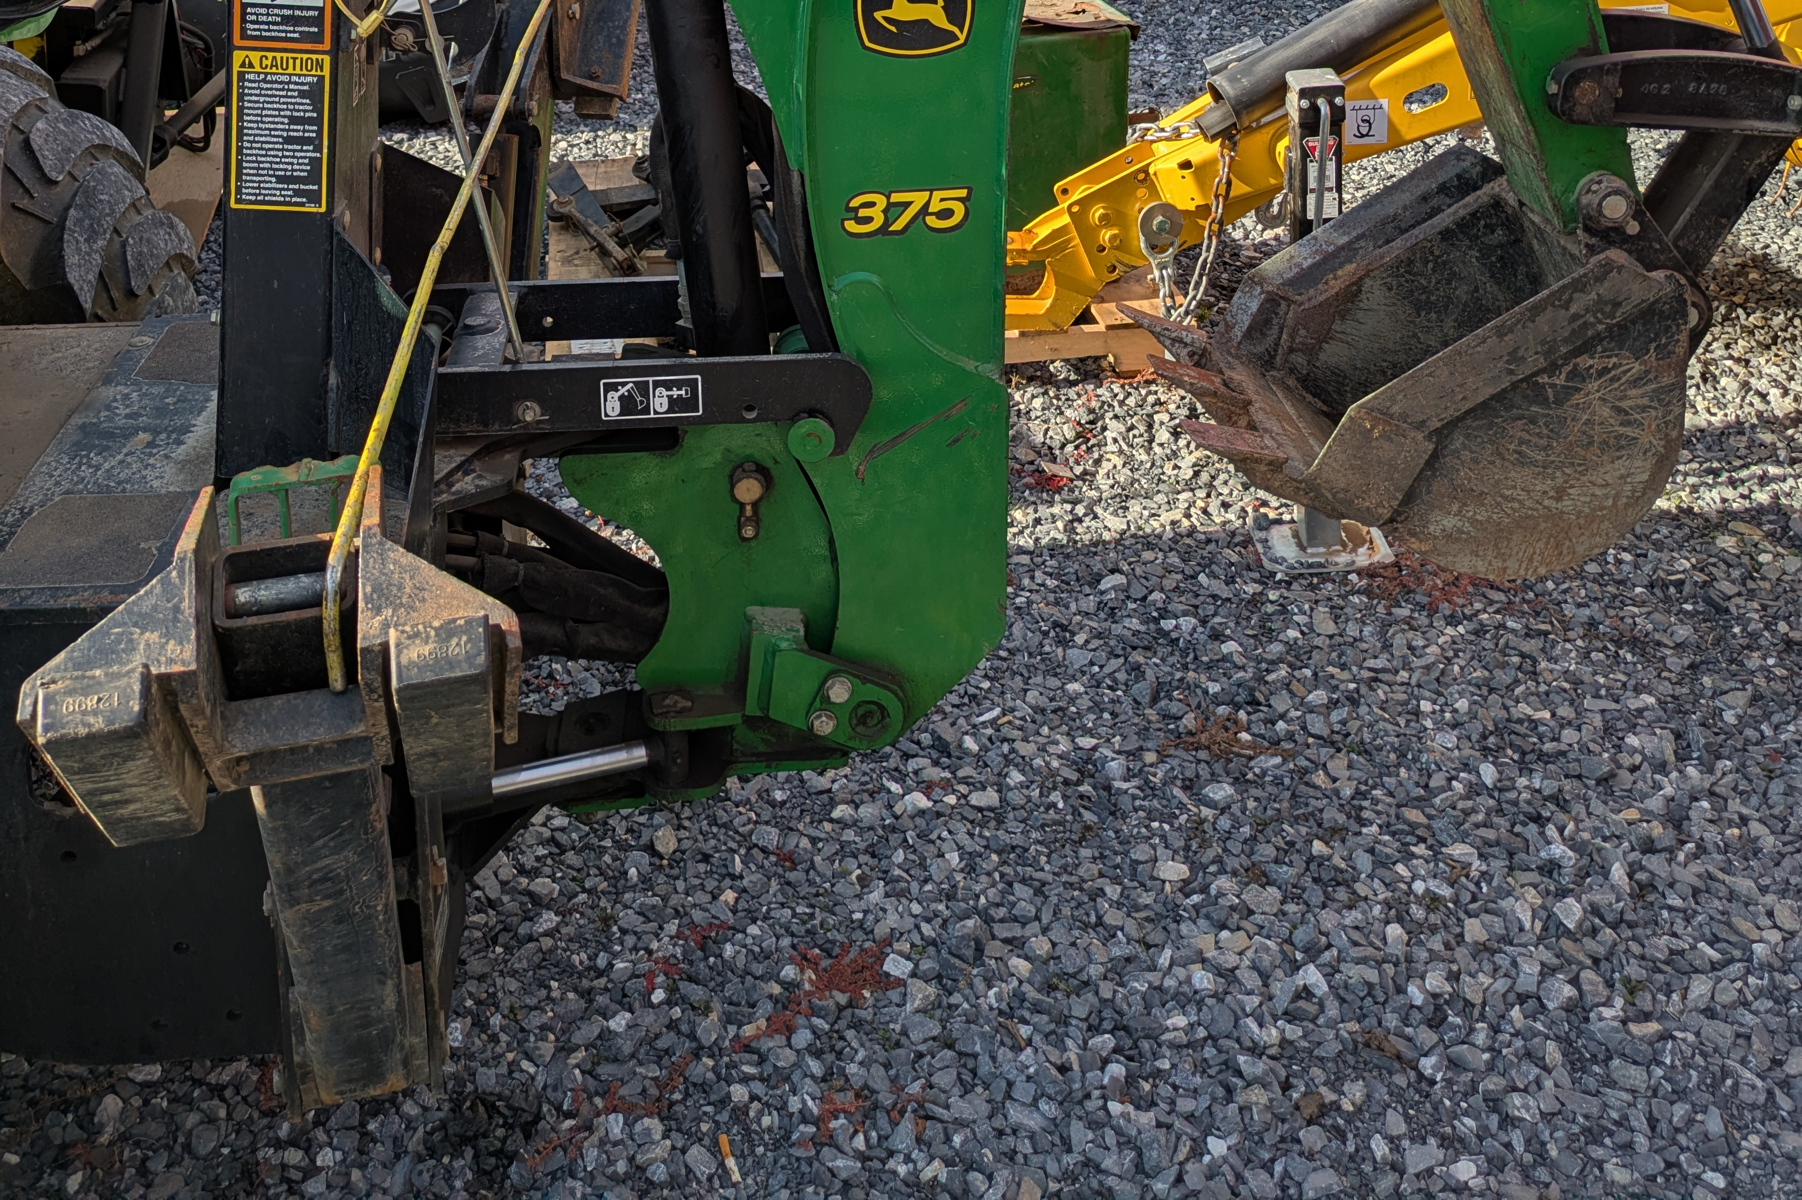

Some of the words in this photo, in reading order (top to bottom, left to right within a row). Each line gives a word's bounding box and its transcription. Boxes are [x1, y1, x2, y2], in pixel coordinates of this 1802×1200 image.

[259, 55, 324, 72] CAUTION
[841, 187, 972, 237] 375
[414, 639, 469, 662] 12899
[63, 692, 122, 714] 12899
